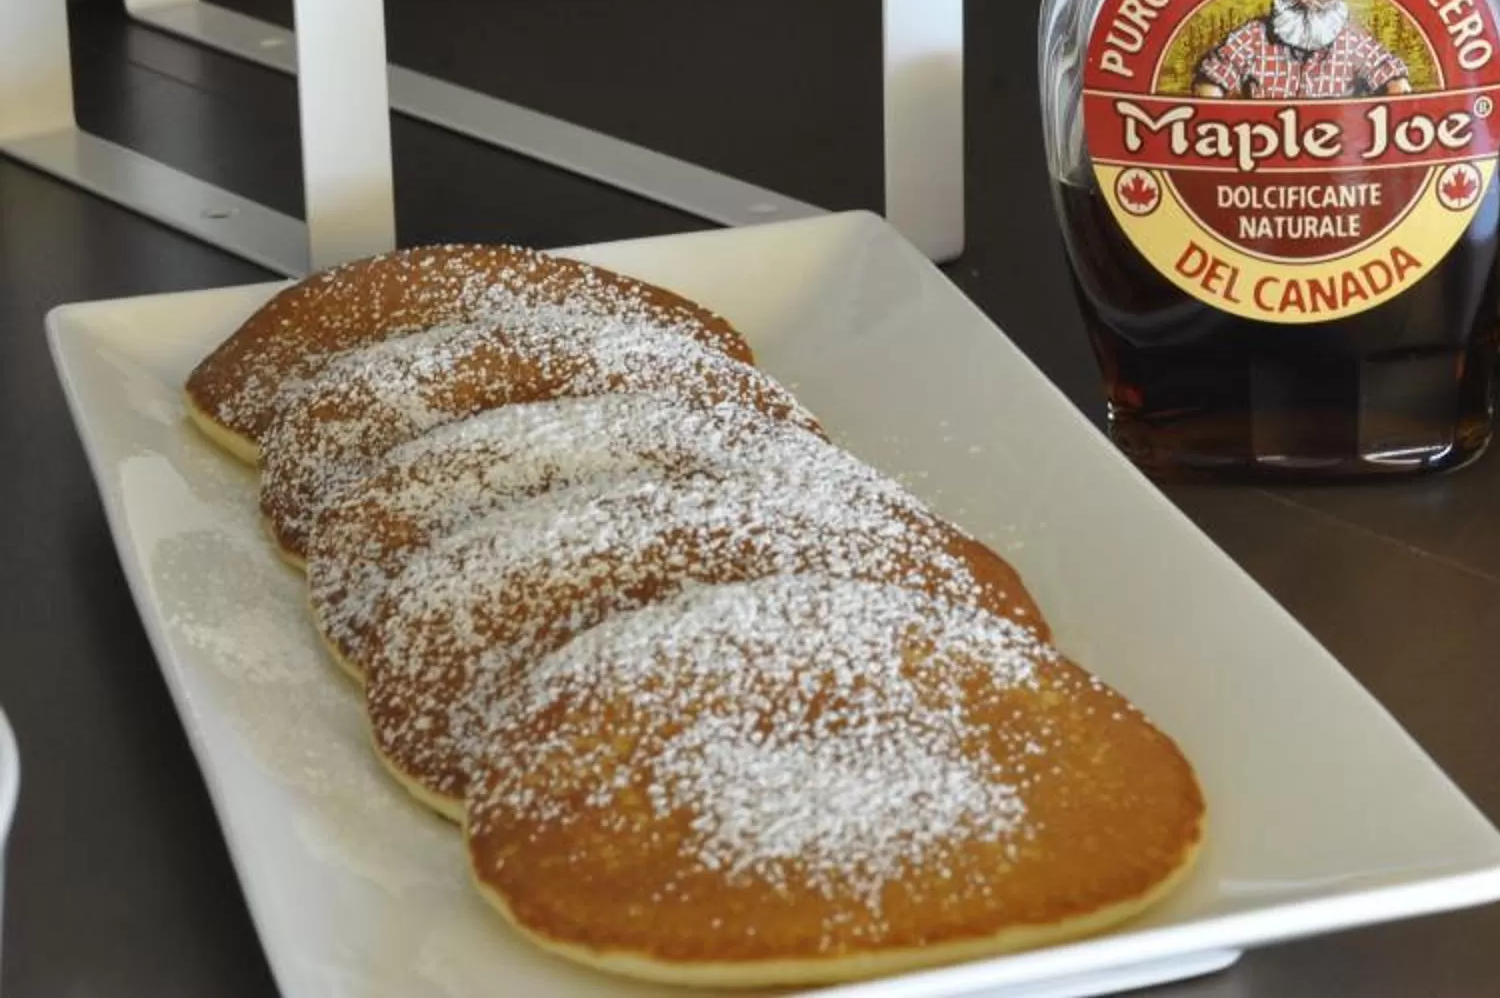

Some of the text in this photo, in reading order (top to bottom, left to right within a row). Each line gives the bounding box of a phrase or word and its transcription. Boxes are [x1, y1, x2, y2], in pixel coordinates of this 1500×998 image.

[1116, 101, 1343, 172] Maple
[1217, 183, 1382, 210] DOLCIFICANTE
[1239, 214, 1361, 240] NATURALE
[1174, 240, 1423, 314] DEL CANADA
